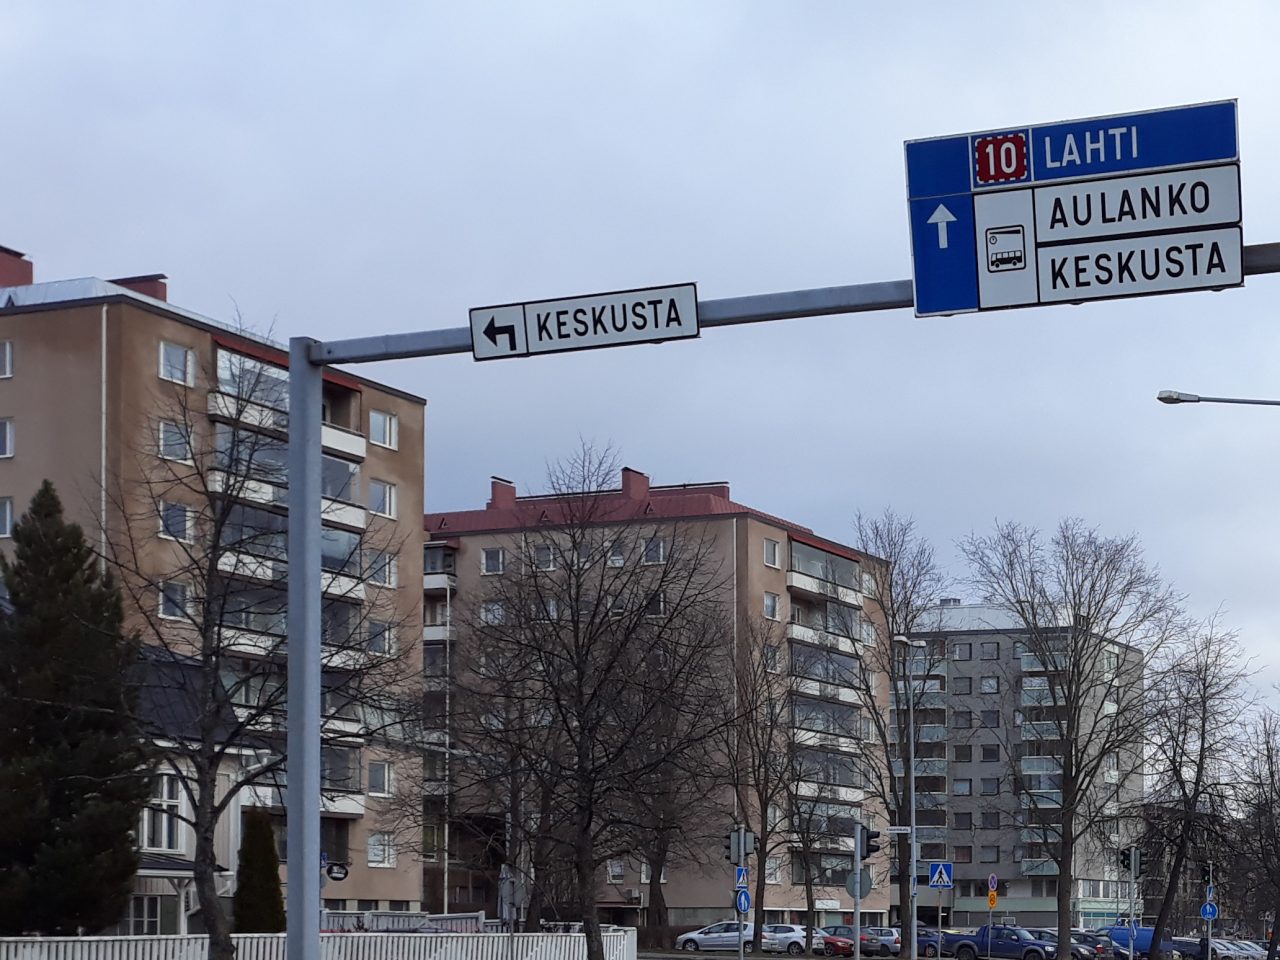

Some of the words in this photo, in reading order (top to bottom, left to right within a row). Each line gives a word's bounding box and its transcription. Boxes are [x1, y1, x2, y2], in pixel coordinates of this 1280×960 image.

[985, 141, 1017, 176] 10
[1044, 126, 1138, 169] LAHTI
[1049, 181, 1210, 230] AULANKO
[1050, 241, 1226, 290] KESKUSTA
[536, 298, 682, 341] KESKUSTA
